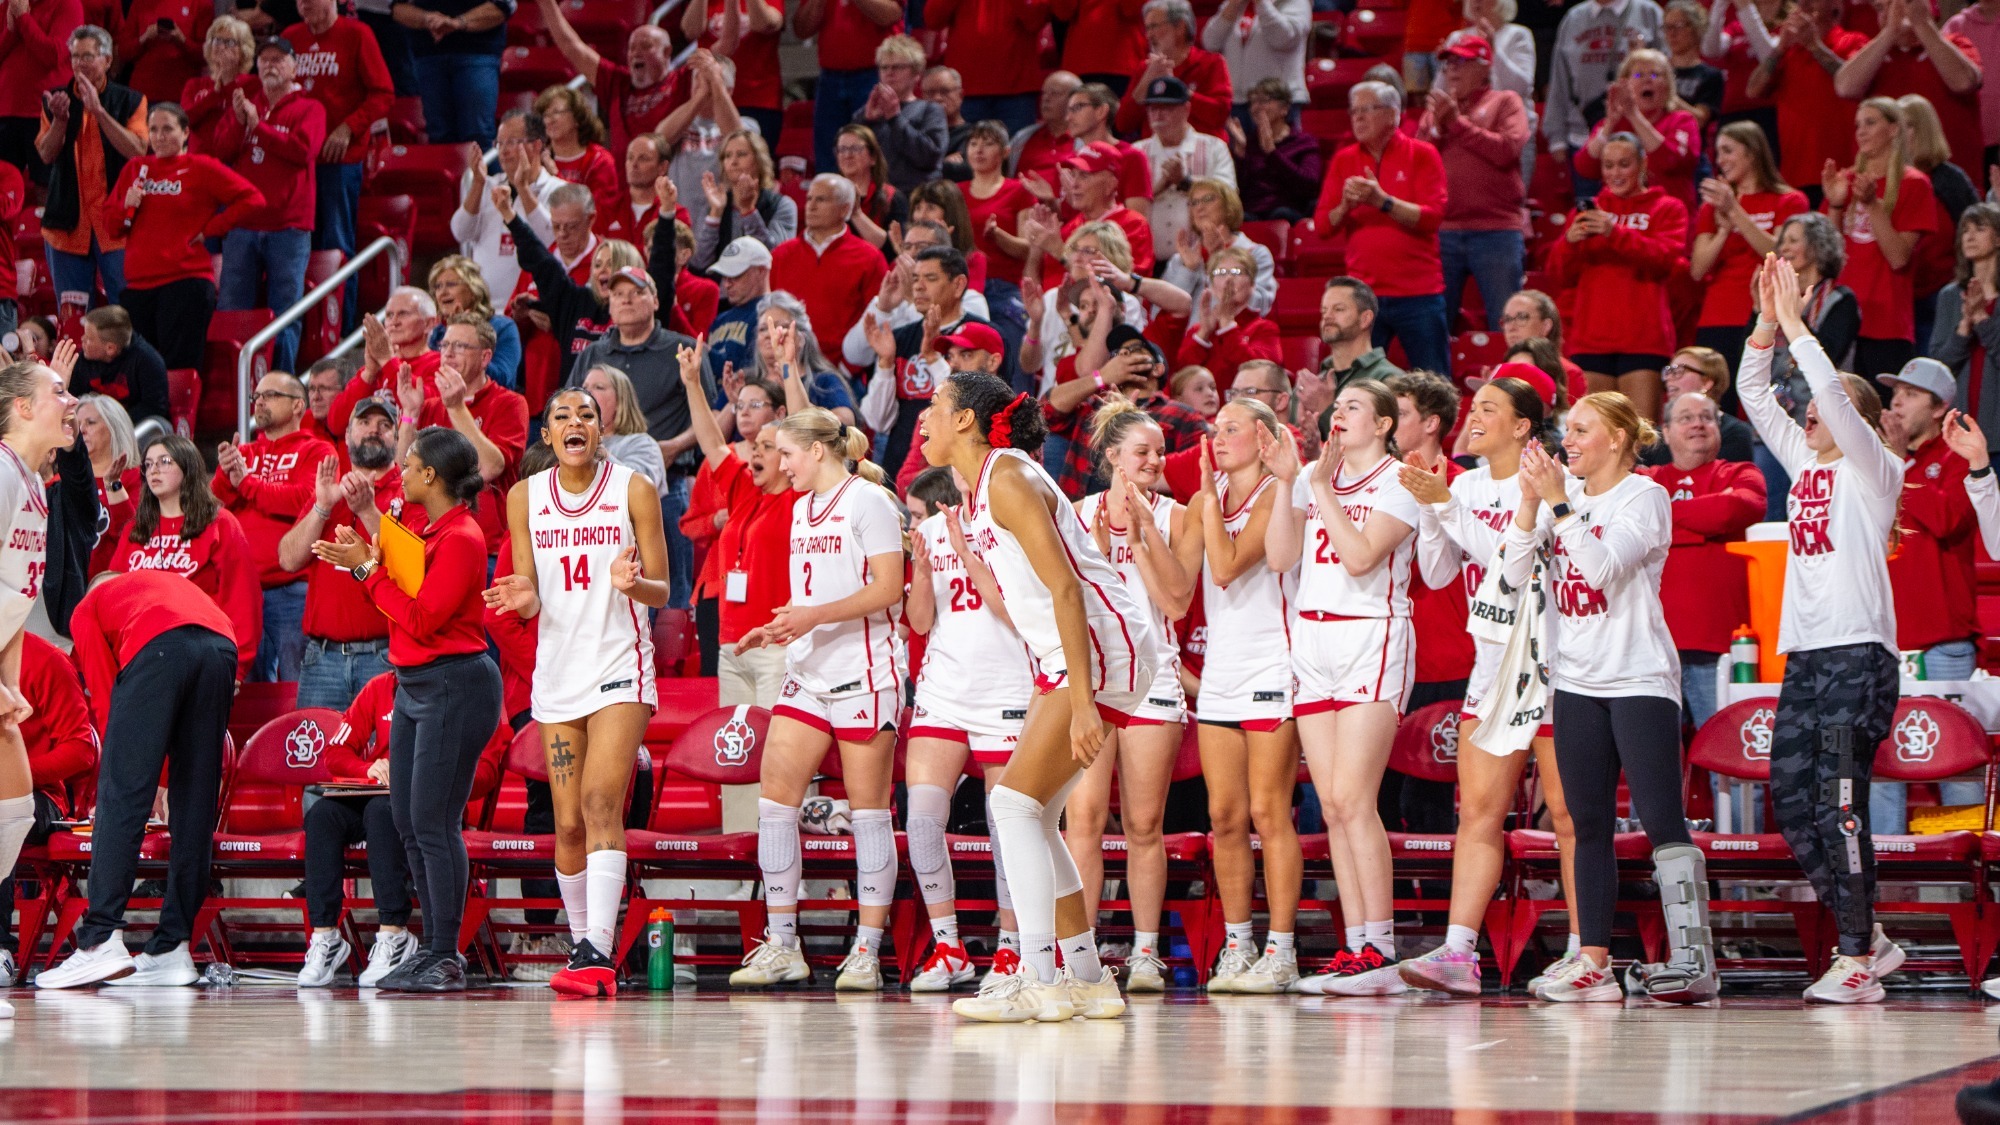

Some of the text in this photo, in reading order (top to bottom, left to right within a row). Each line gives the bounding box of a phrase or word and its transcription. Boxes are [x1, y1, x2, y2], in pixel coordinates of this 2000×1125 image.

[296, 62, 340, 77] AKOTA
[535, 526, 621, 549] SOUTH DAKOTA
[806, 535, 842, 554] DAKOTA
[1789, 519, 1836, 556] OCK
[129, 547, 199, 578] Dakota
[933, 553, 958, 573] OUTH
[560, 554, 591, 592] 14
[803, 561, 812, 597] 2
[949, 576, 983, 613] 25
[219, 841, 262, 852] COYOTES
[492, 840, 535, 850] COYOTES
[655, 840, 699, 851] COYOTES
[805, 840, 849, 850] COYOTES
[953, 841, 992, 852] COYOTE
[1102, 840, 1127, 850] COYO
[1404, 840, 1452, 850] COYOTES
[1711, 840, 1760, 850] COYOTES
